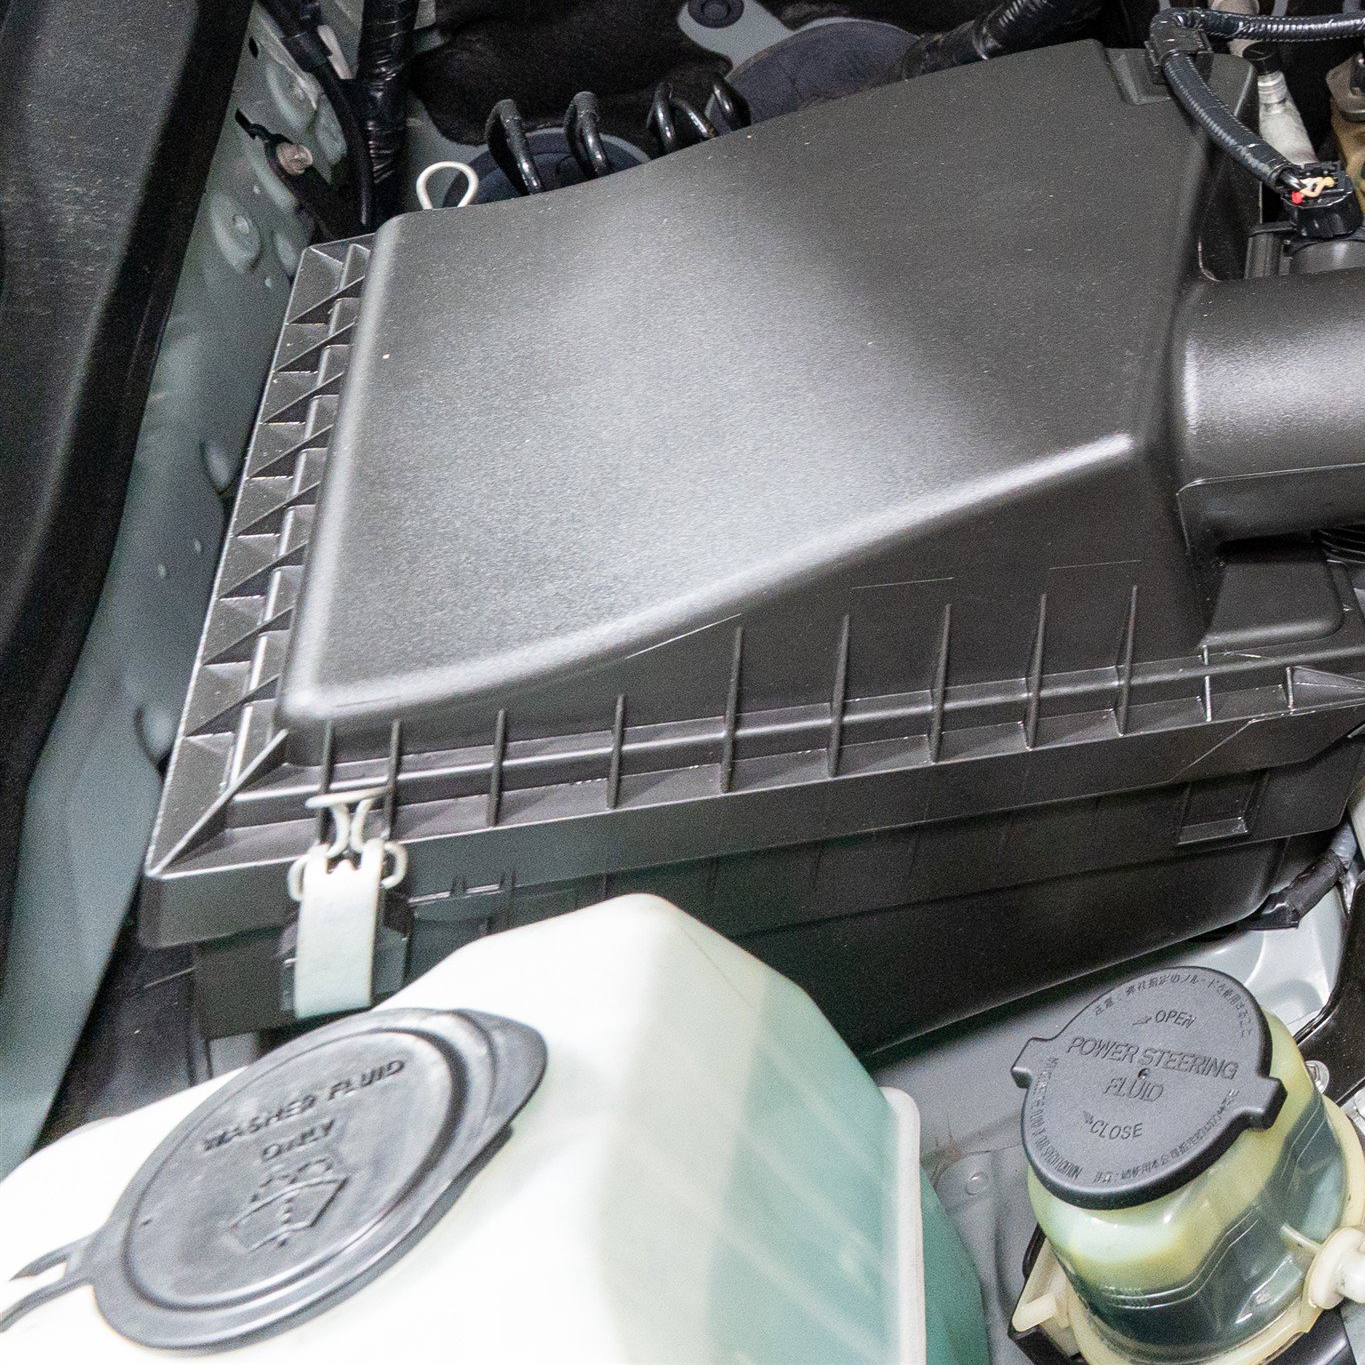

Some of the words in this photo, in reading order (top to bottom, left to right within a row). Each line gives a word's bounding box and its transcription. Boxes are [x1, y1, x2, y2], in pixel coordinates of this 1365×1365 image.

[1154, 1009, 1197, 1029] OPEN
[1065, 1035, 1141, 1063] POWER
[1137, 1046, 1240, 1081] STEERING
[327, 1058, 406, 1101] FLUID
[1102, 1075, 1165, 1103] FLUID
[1089, 1120, 1144, 1141] CLOSE
